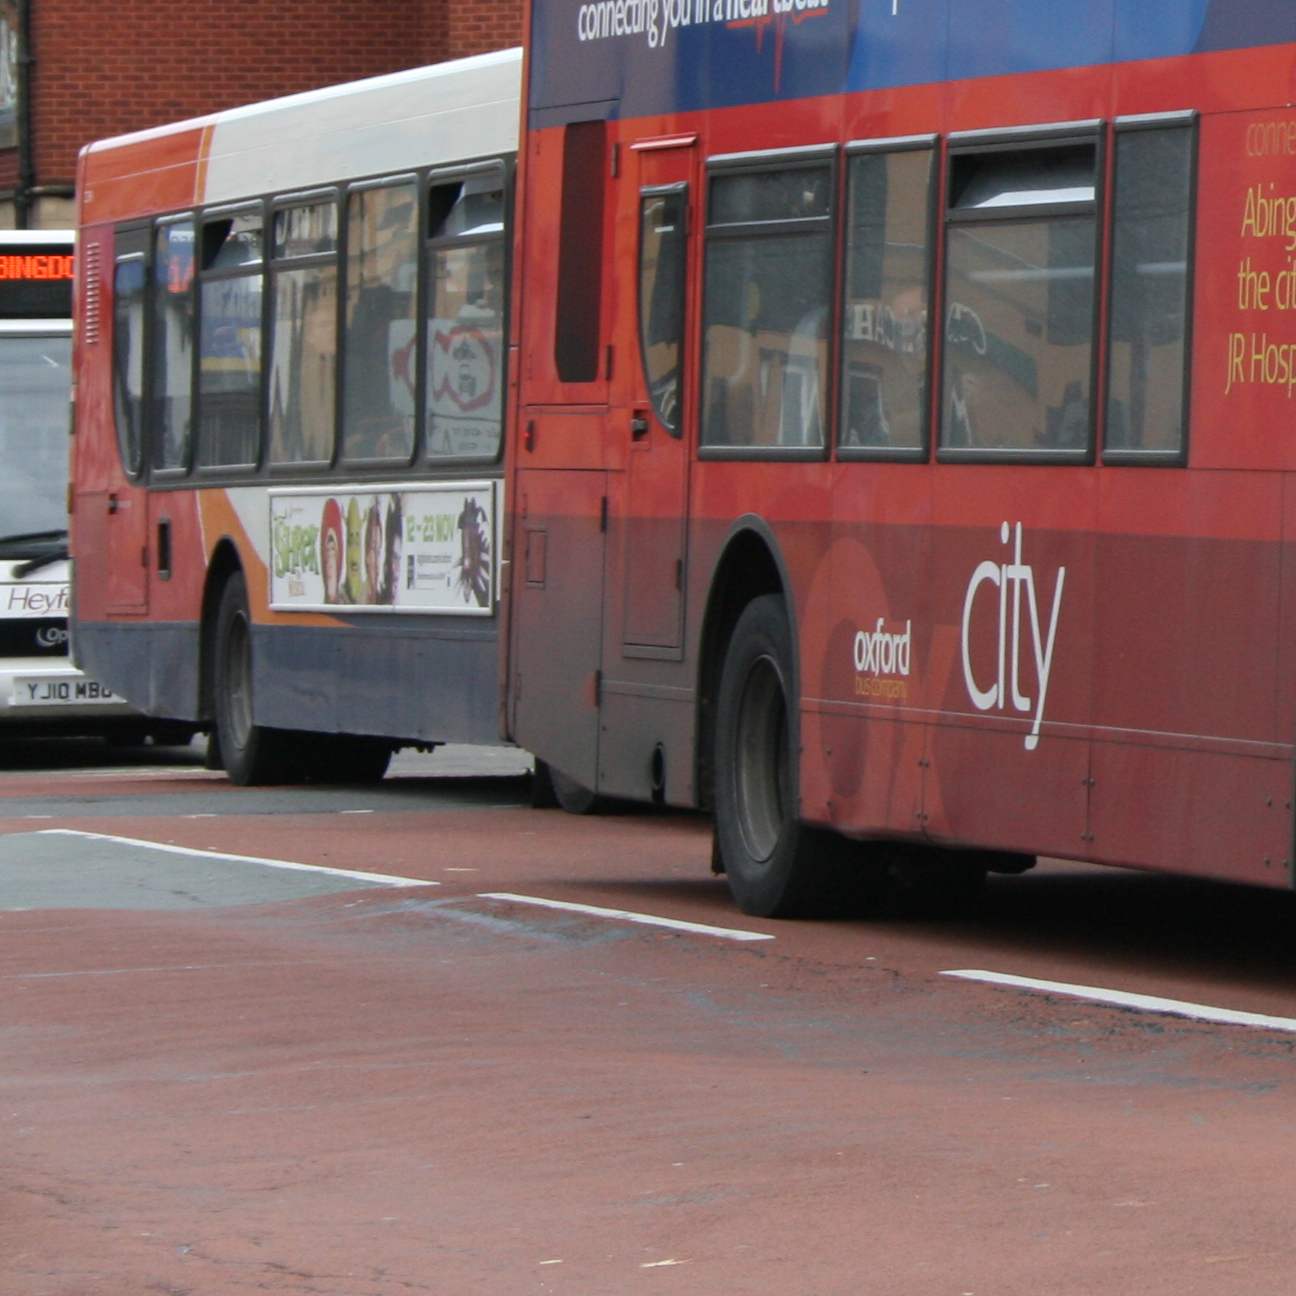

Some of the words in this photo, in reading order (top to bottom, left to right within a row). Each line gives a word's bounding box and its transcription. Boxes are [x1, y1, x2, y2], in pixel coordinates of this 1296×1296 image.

[1237, 257, 1271, 311] the
[1224, 332, 1246, 395] JR
[854, 617, 912, 677] oxford
[961, 520, 1067, 752] city
[27, 682, 70, 700] YJ10
